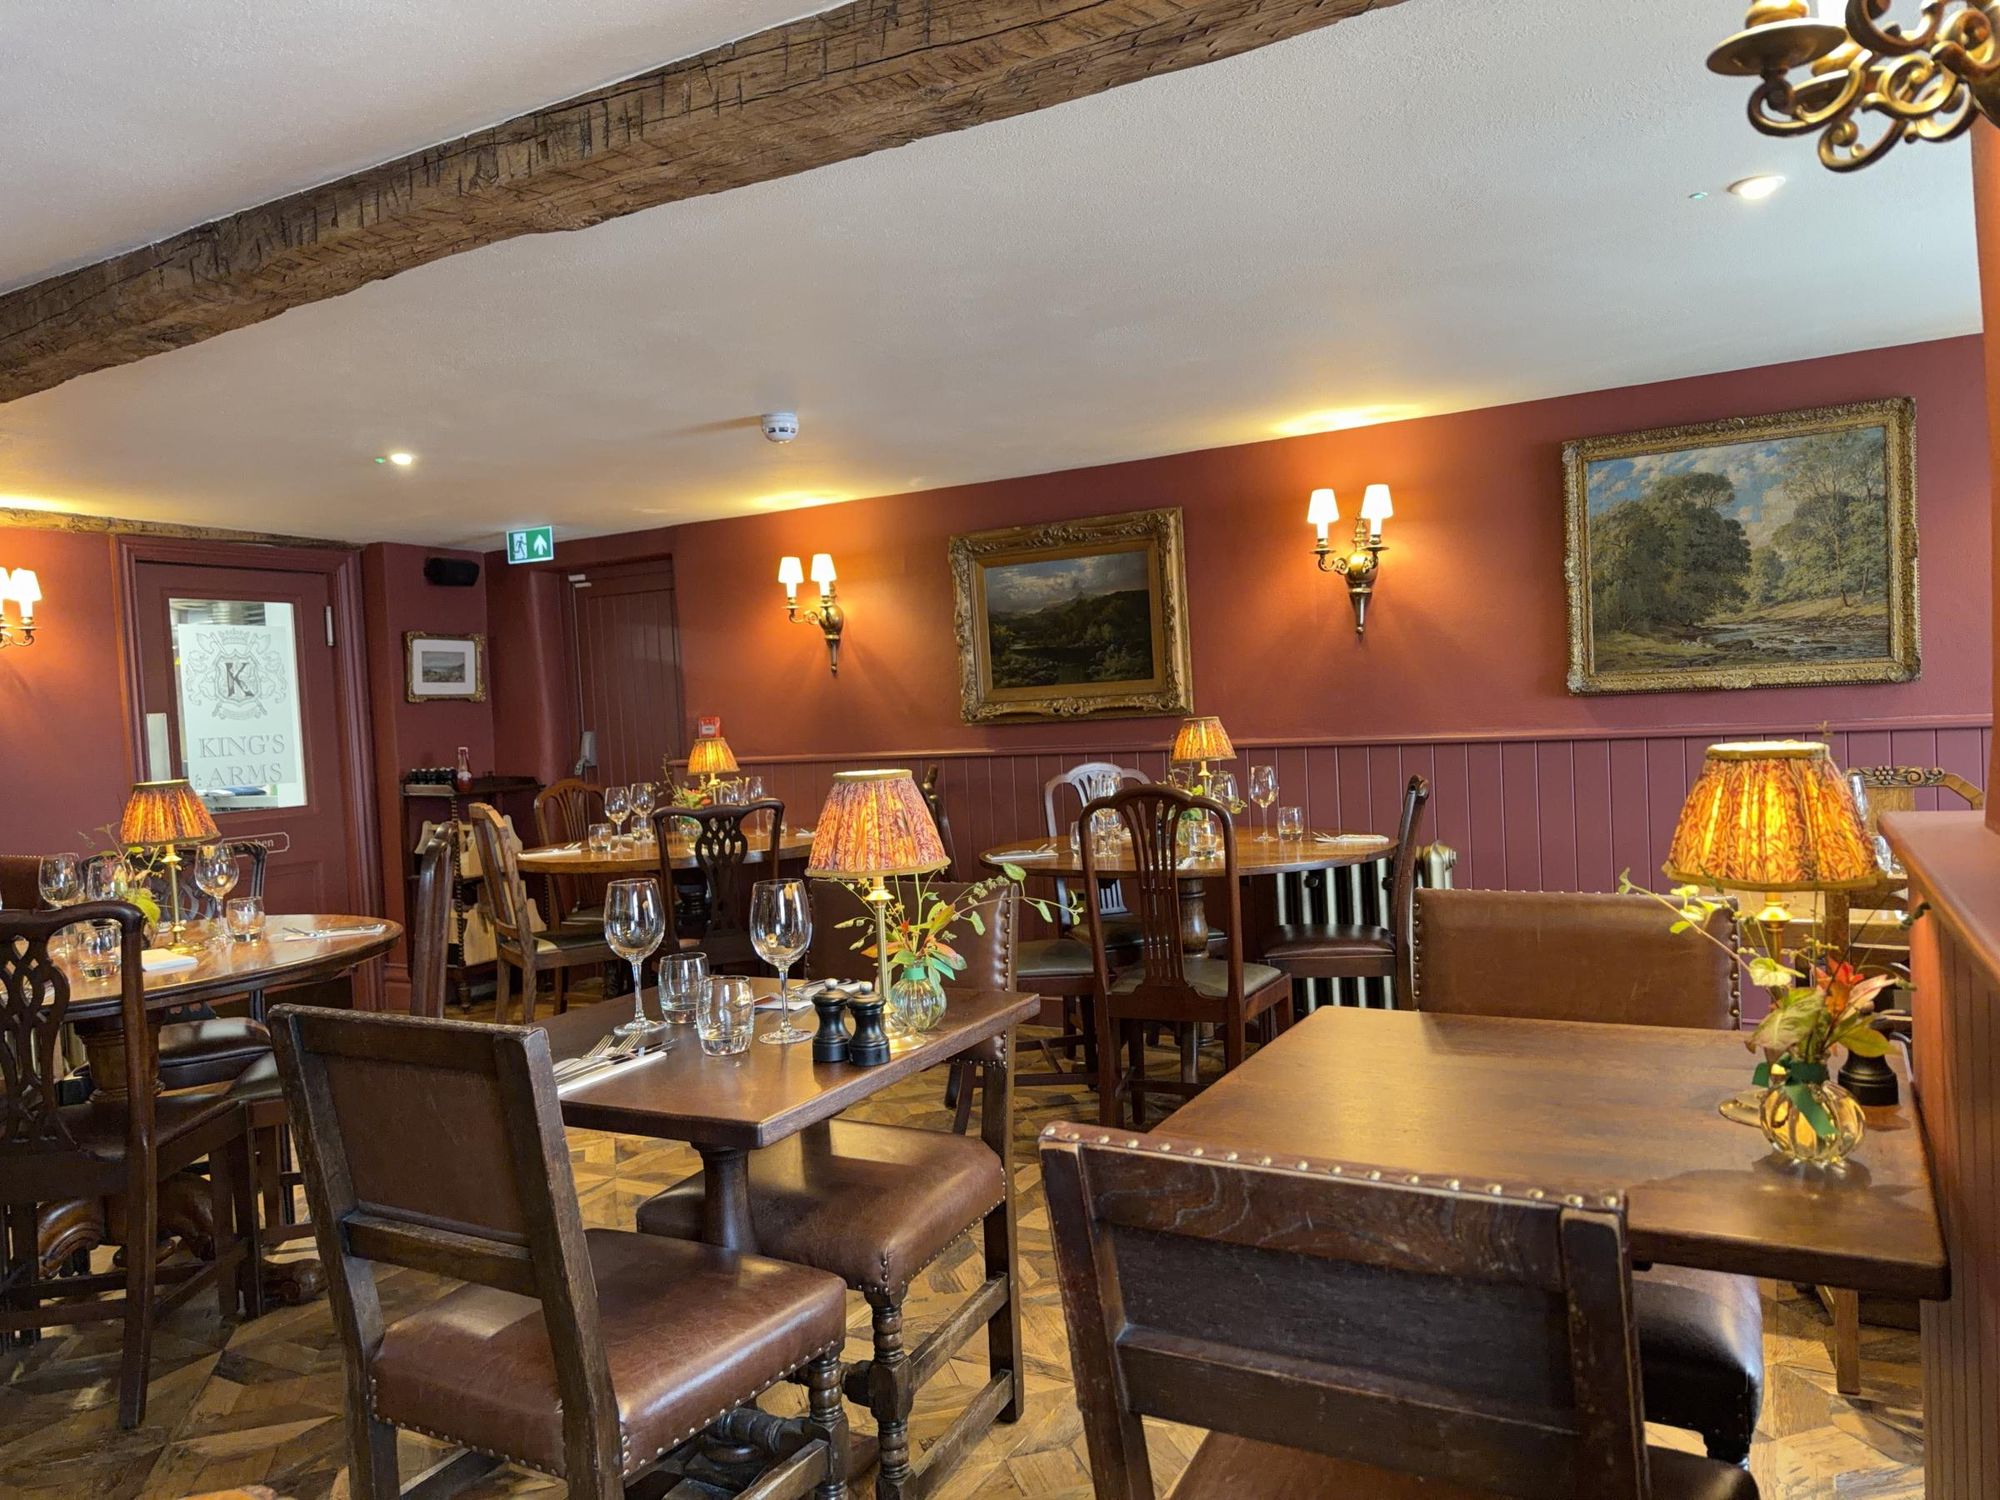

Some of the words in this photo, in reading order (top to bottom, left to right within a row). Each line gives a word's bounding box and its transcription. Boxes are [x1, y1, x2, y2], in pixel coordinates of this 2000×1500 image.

[225, 662, 255, 698] K
[198, 733, 285, 758] KING'S
[207, 762, 283, 788] ARMS
